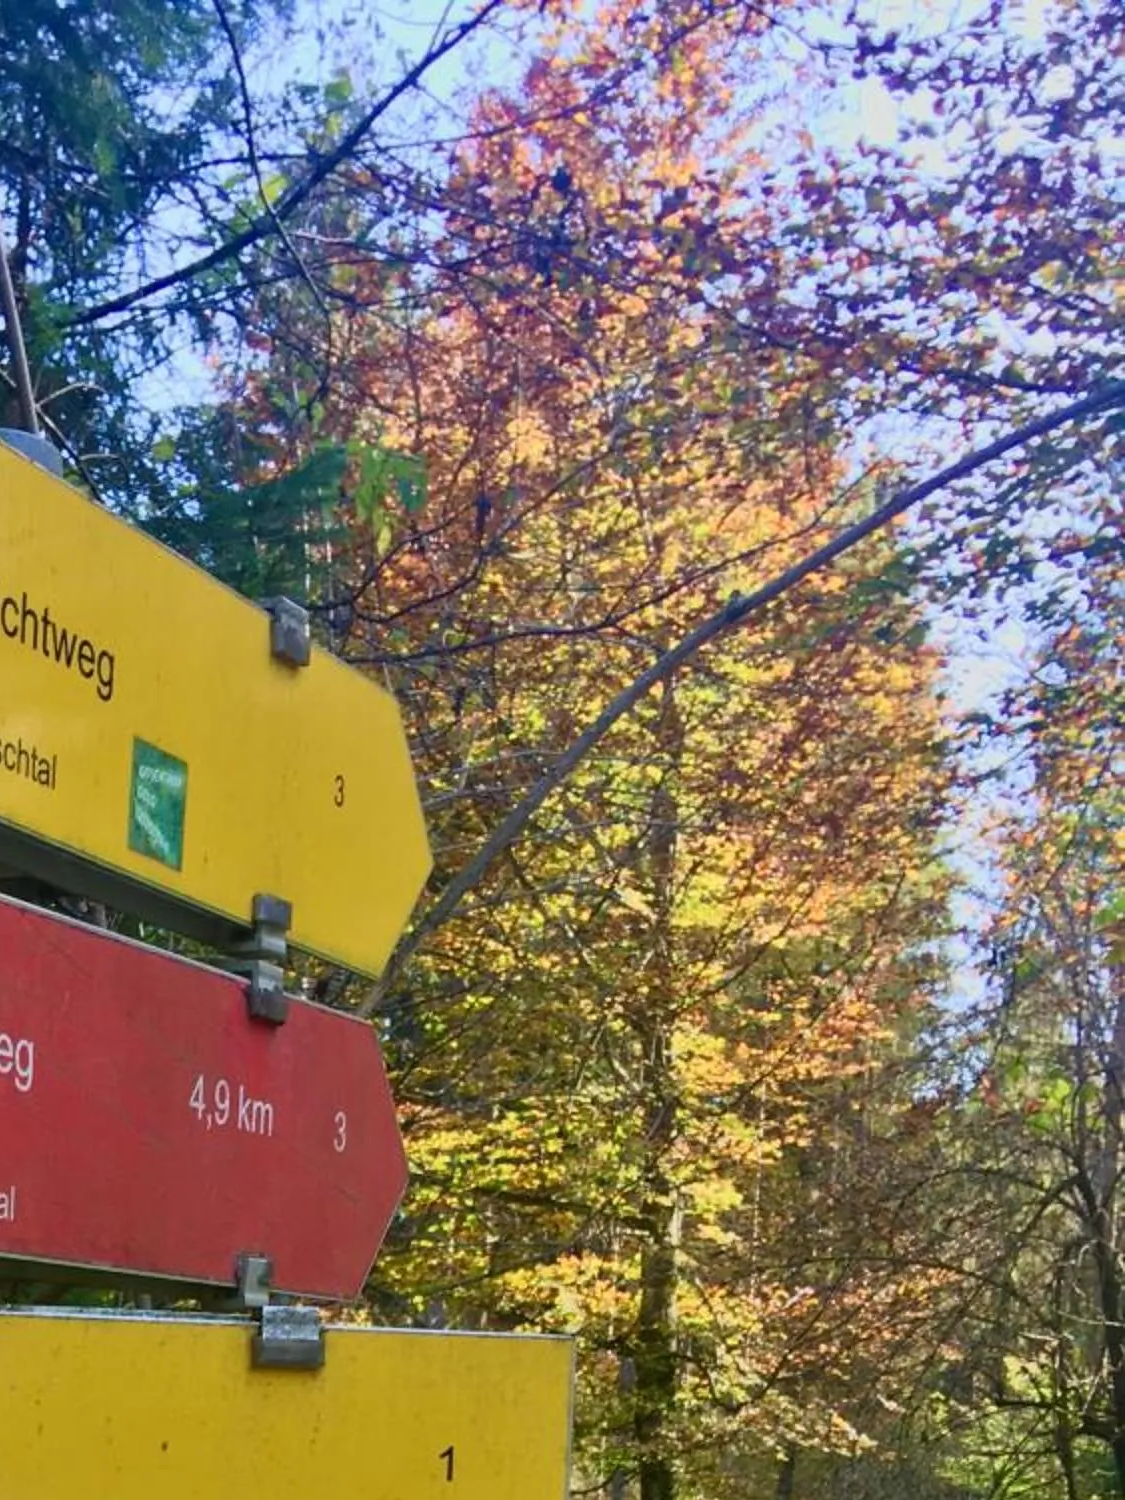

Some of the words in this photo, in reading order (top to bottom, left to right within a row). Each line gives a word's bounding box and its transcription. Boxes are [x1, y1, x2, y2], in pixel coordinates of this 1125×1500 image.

[334, 774, 345, 809] 3
[189, 1074, 231, 1131] 4,9
[238, 1084, 274, 1137] km
[333, 1111, 348, 1153] 3
[438, 1445, 455, 1482] 1
